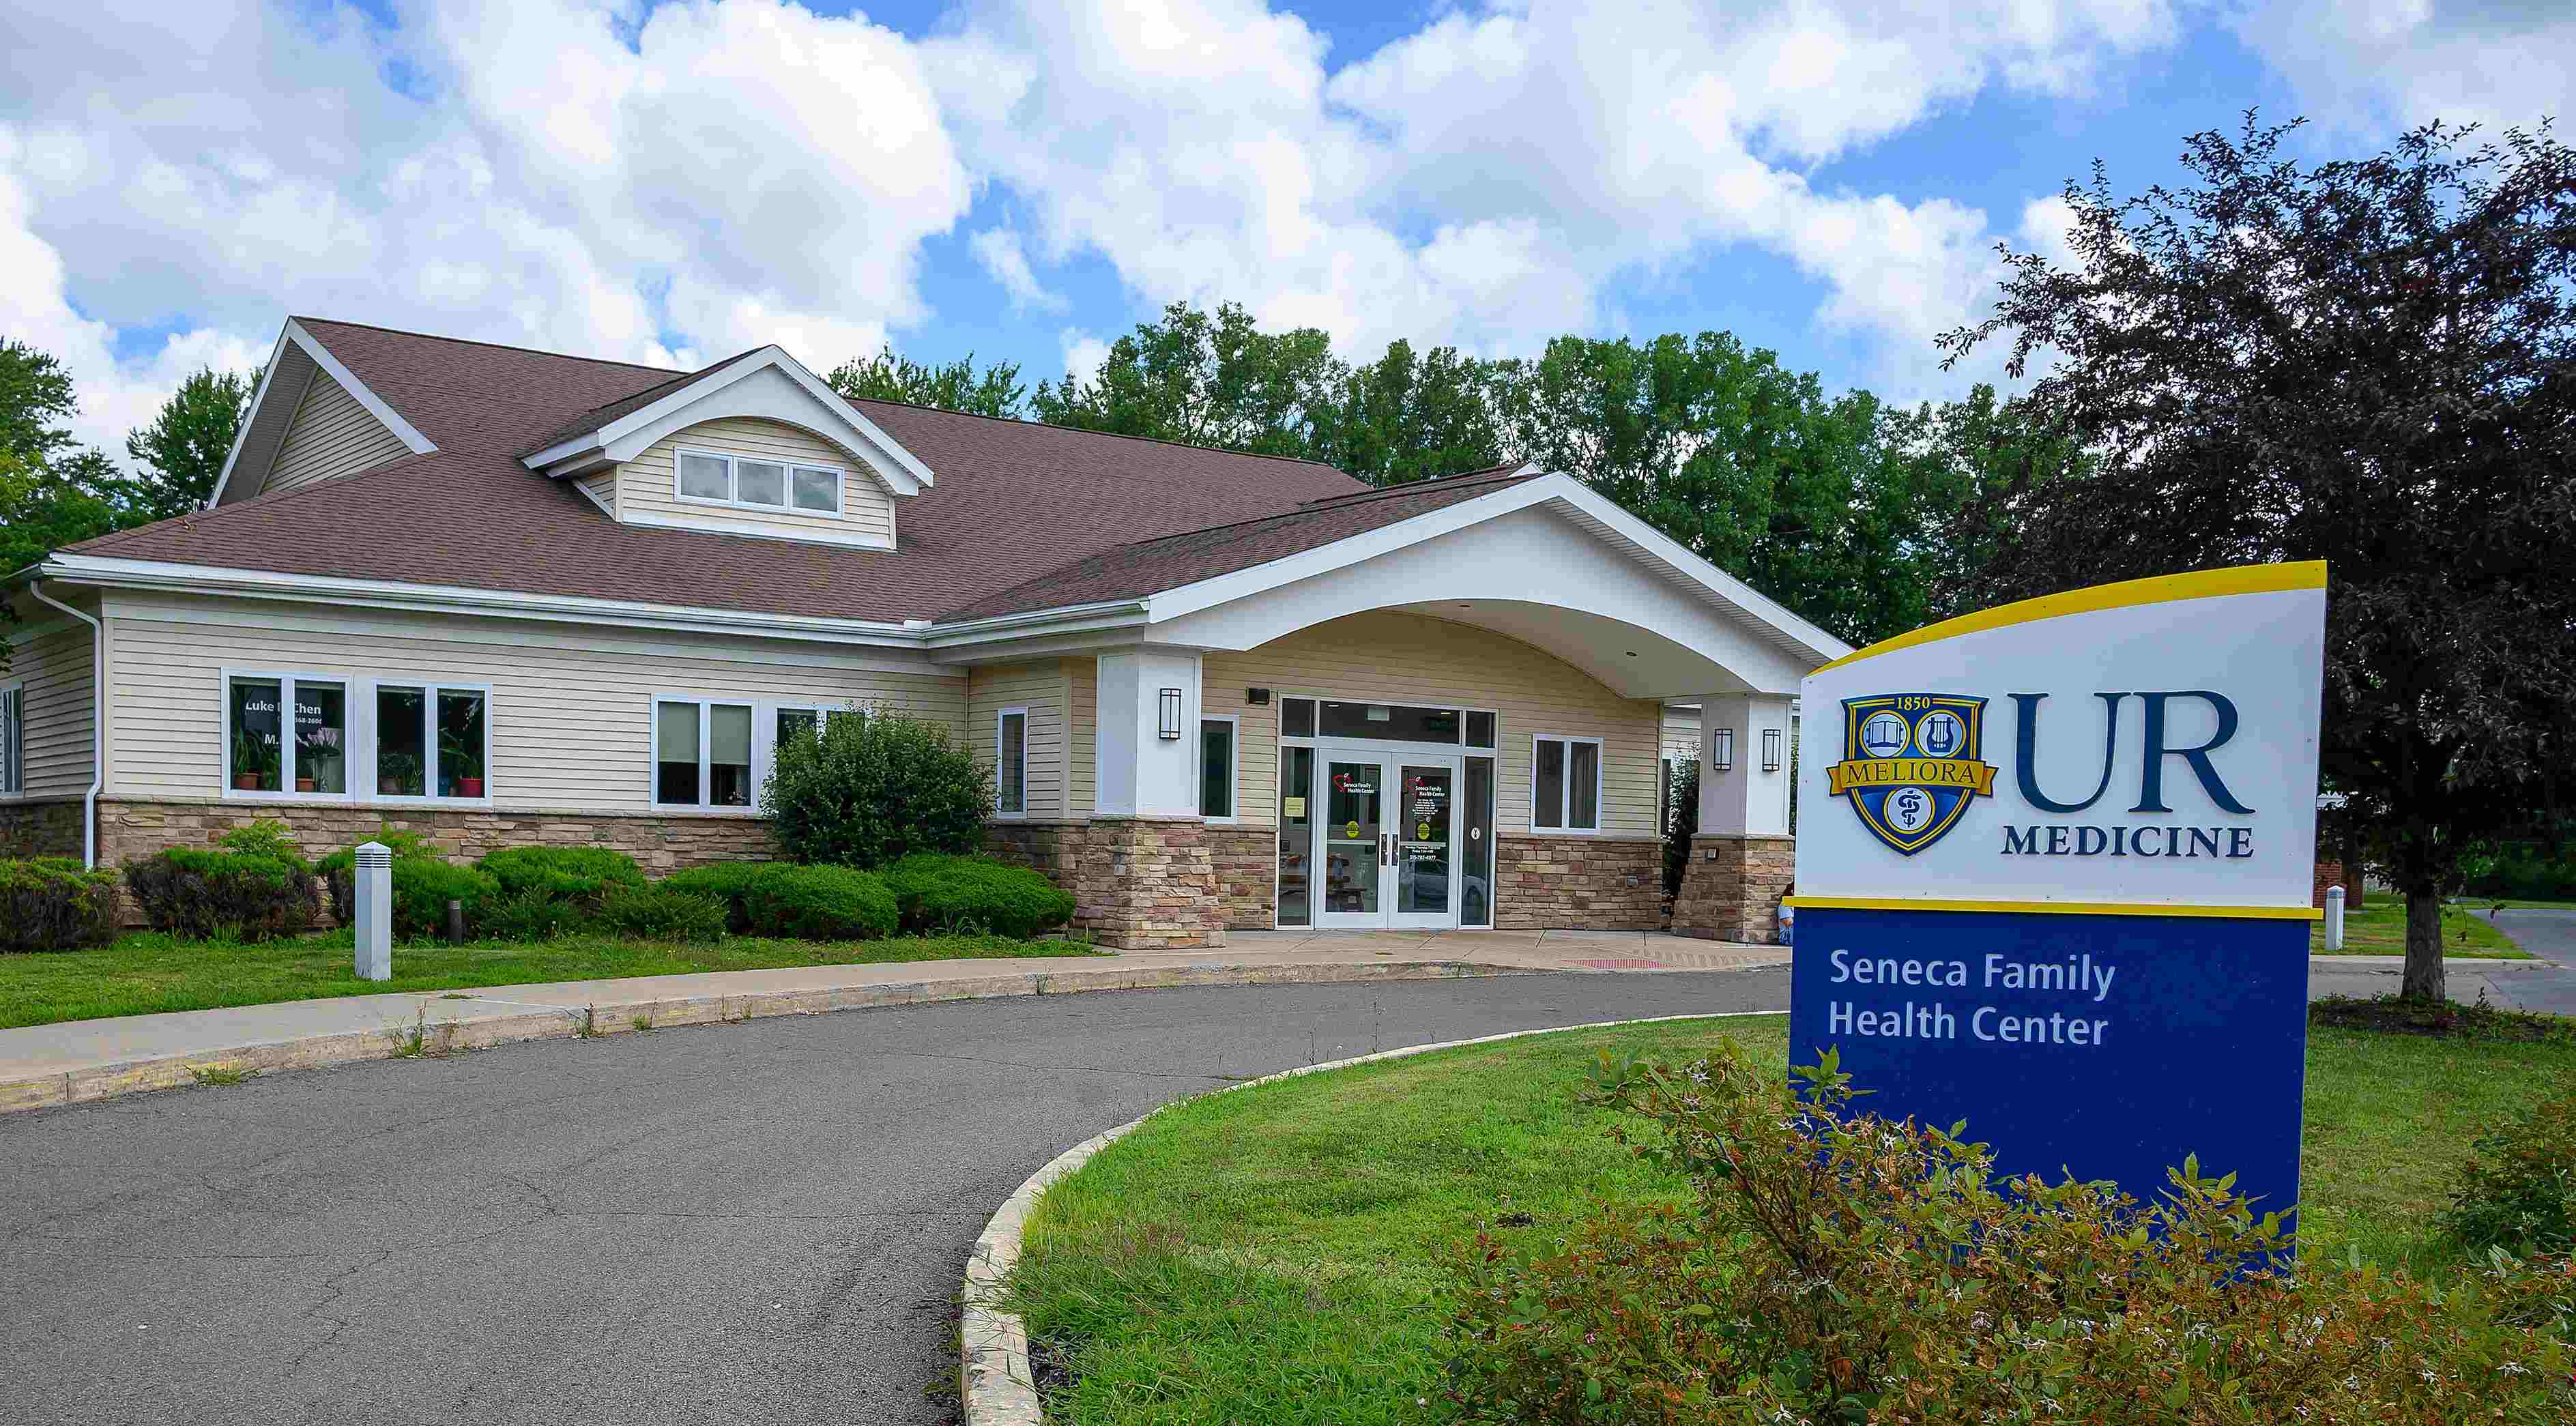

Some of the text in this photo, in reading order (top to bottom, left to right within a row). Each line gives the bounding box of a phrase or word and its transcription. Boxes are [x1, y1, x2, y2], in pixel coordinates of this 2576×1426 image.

[246, 700, 274, 711] Luke
[1896, 697, 1930, 710] 1850
[2007, 690, 2256, 814] UR
[1846, 761, 1976, 784] MELIORA
[2001, 825, 2255, 858] MEDICINE
[1830, 949, 2115, 1002] Seneca Family
[1829, 1001, 2109, 1045] Health Center
